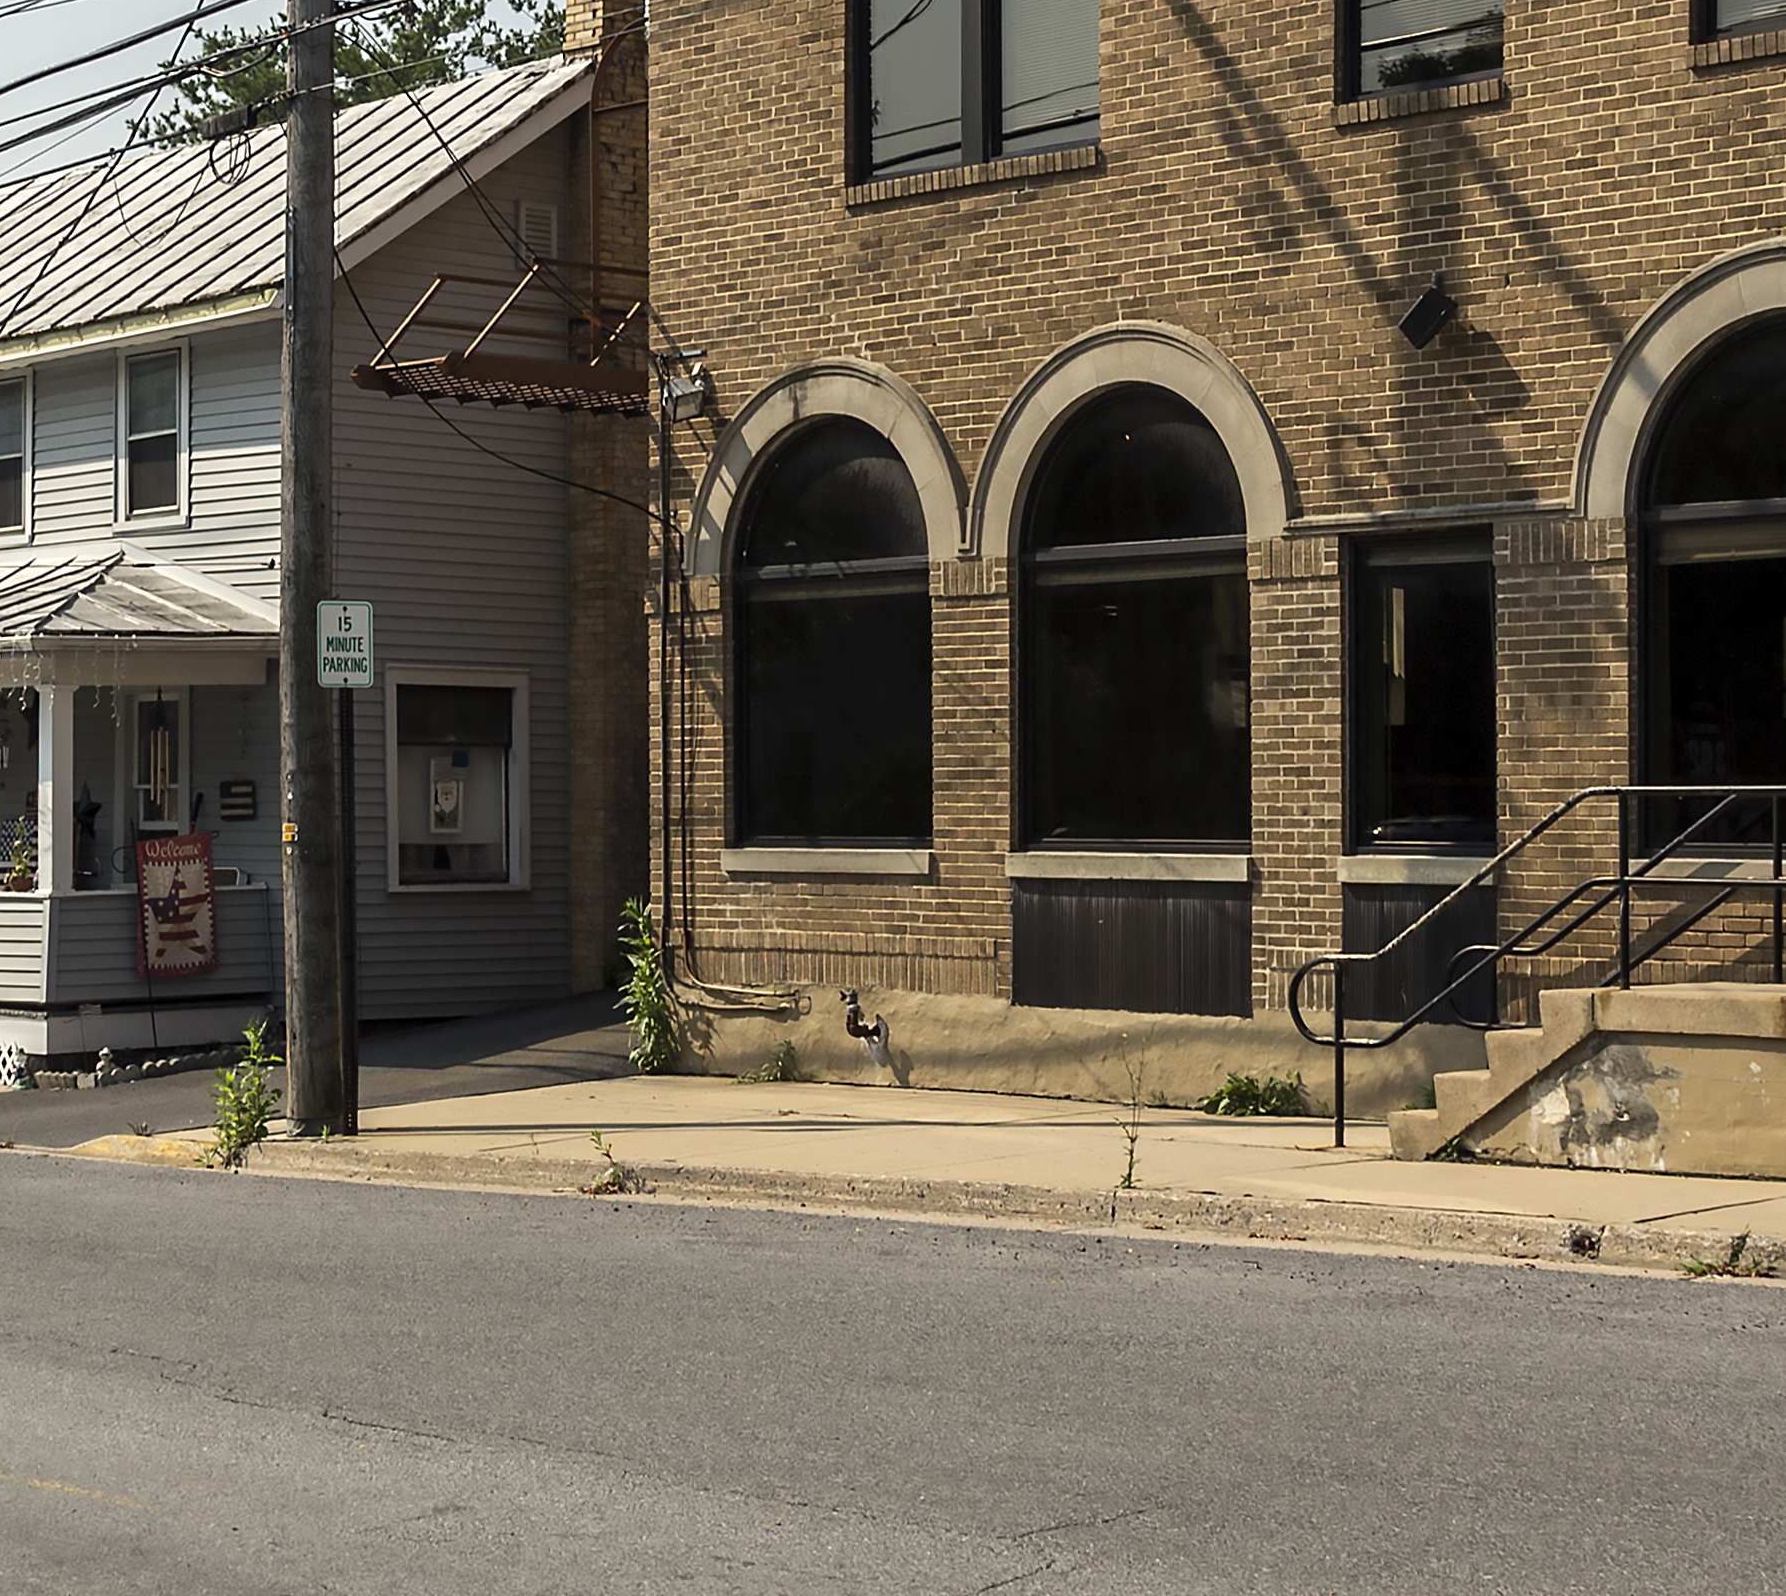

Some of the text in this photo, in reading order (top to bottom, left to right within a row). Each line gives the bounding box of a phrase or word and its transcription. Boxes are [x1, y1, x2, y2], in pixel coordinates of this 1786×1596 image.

[338, 616, 352, 632] 15
[326, 636, 364, 653] MINUTE
[323, 657, 368, 673] PARKING
[145, 841, 201, 858] Welcome
